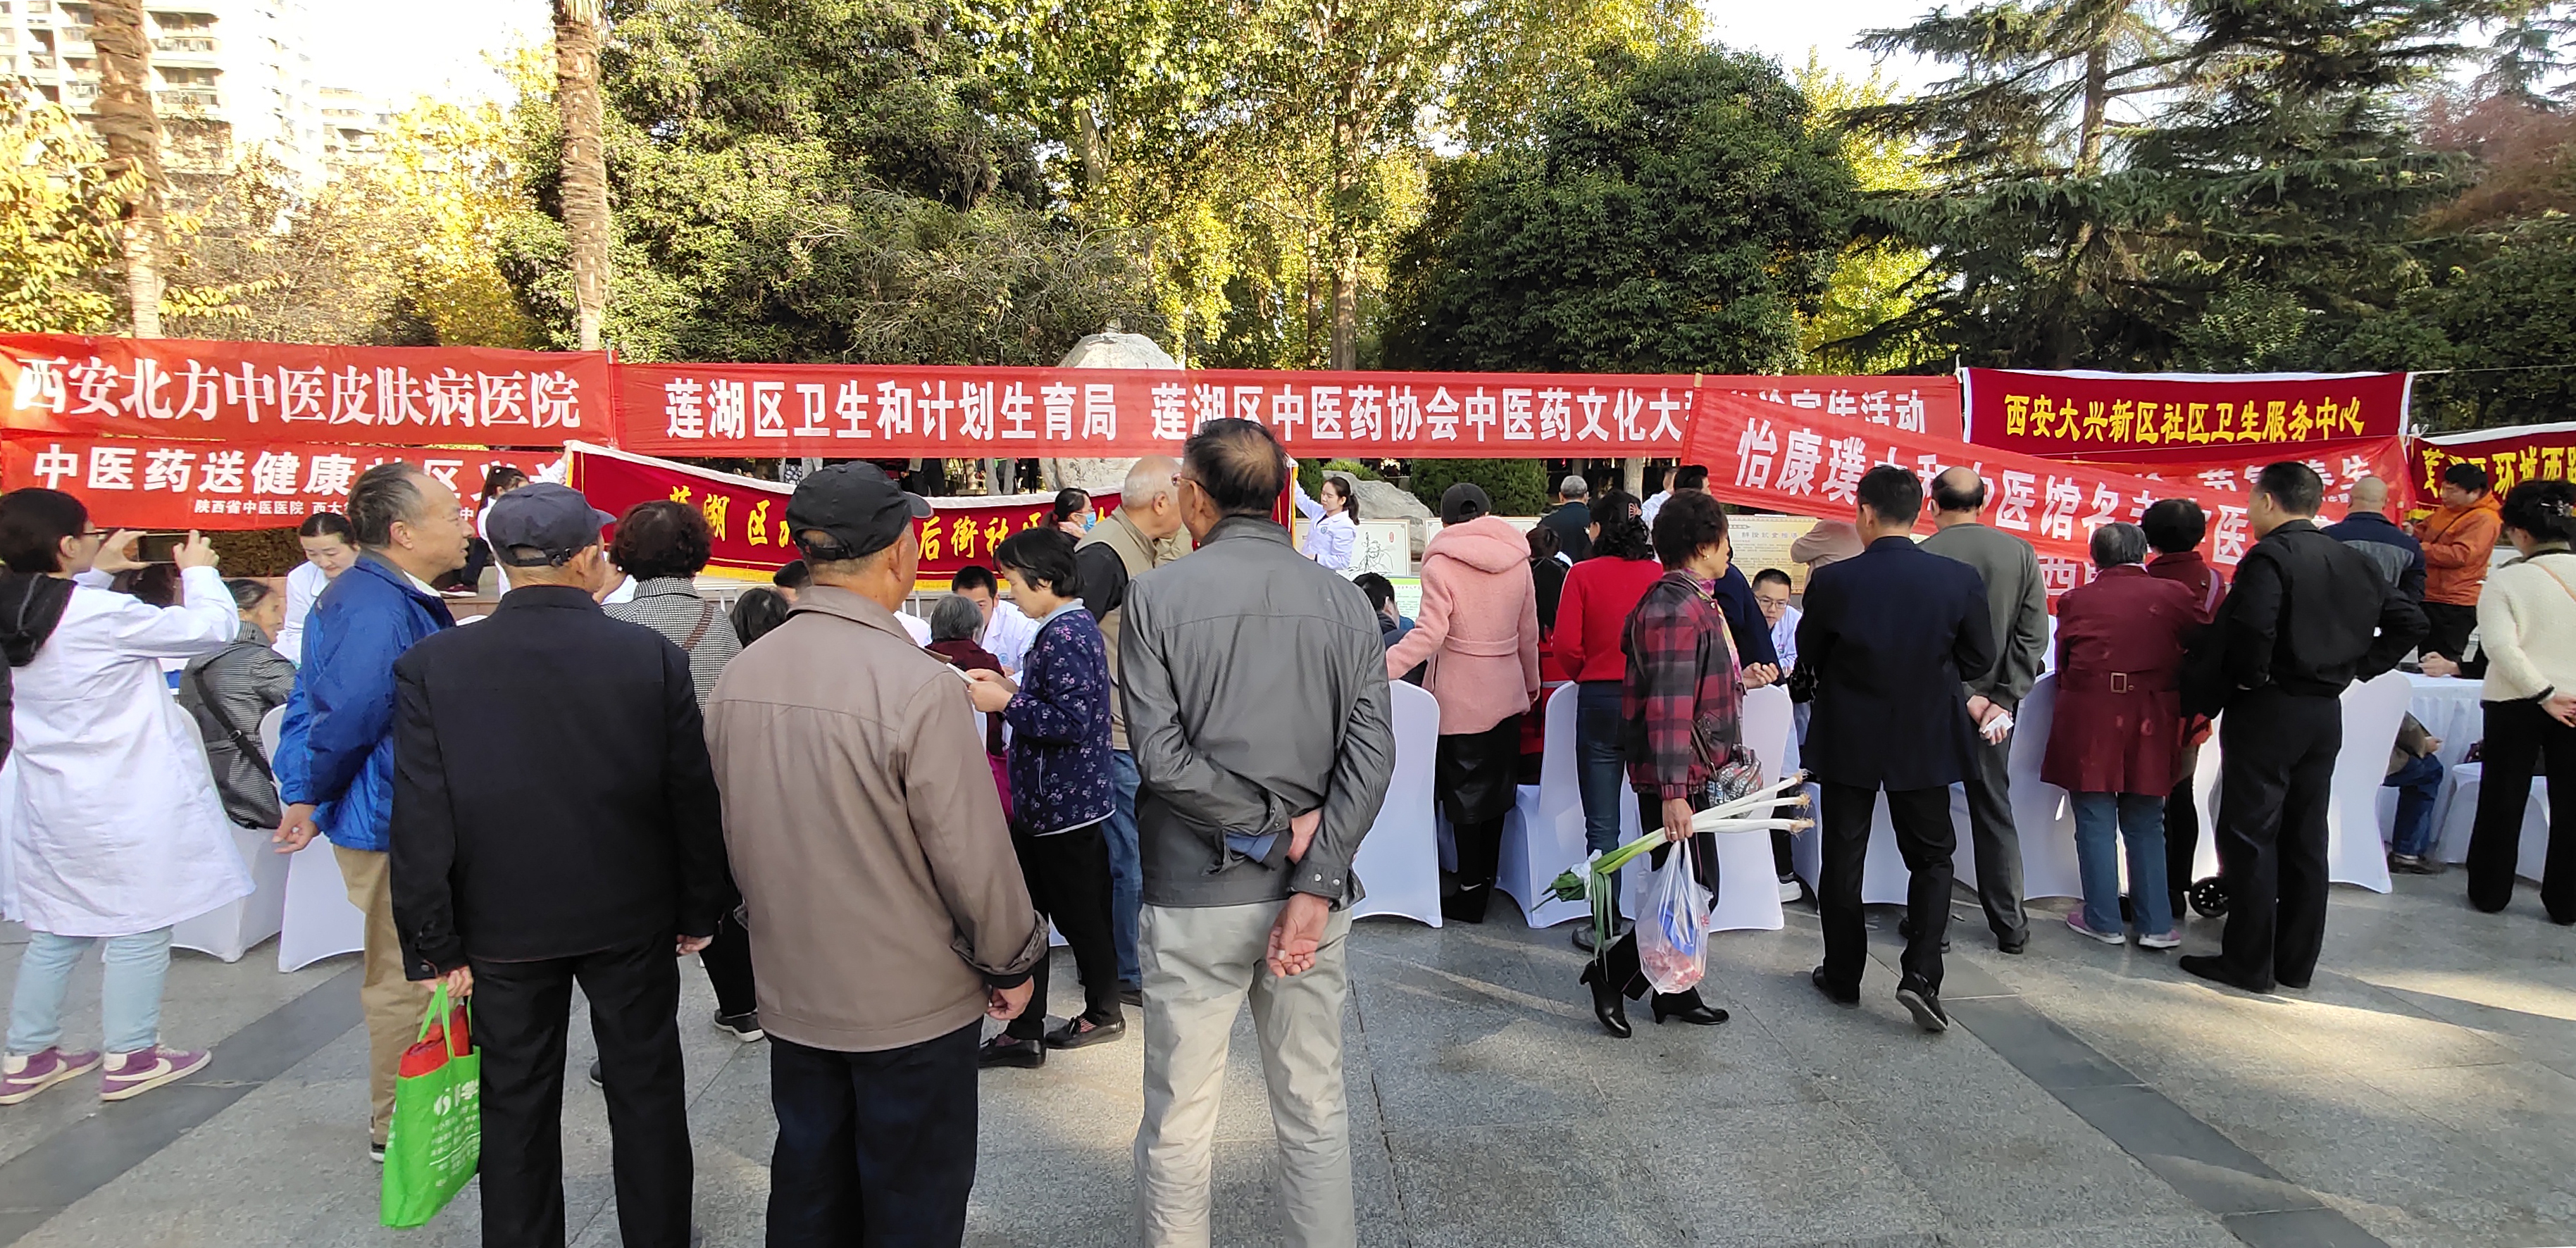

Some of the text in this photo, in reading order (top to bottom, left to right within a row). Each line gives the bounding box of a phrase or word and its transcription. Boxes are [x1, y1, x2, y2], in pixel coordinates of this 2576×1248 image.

[14, 355, 580, 428] 西安北方中医皮肤病医院
[665, 376, 1116, 442] 莲湖区卫生和计划生育局
[2004, 394, 2365, 444] 西安大兴新区社区卫生服务中心
[194, 499, 304, 515] 陕西省中医医院
